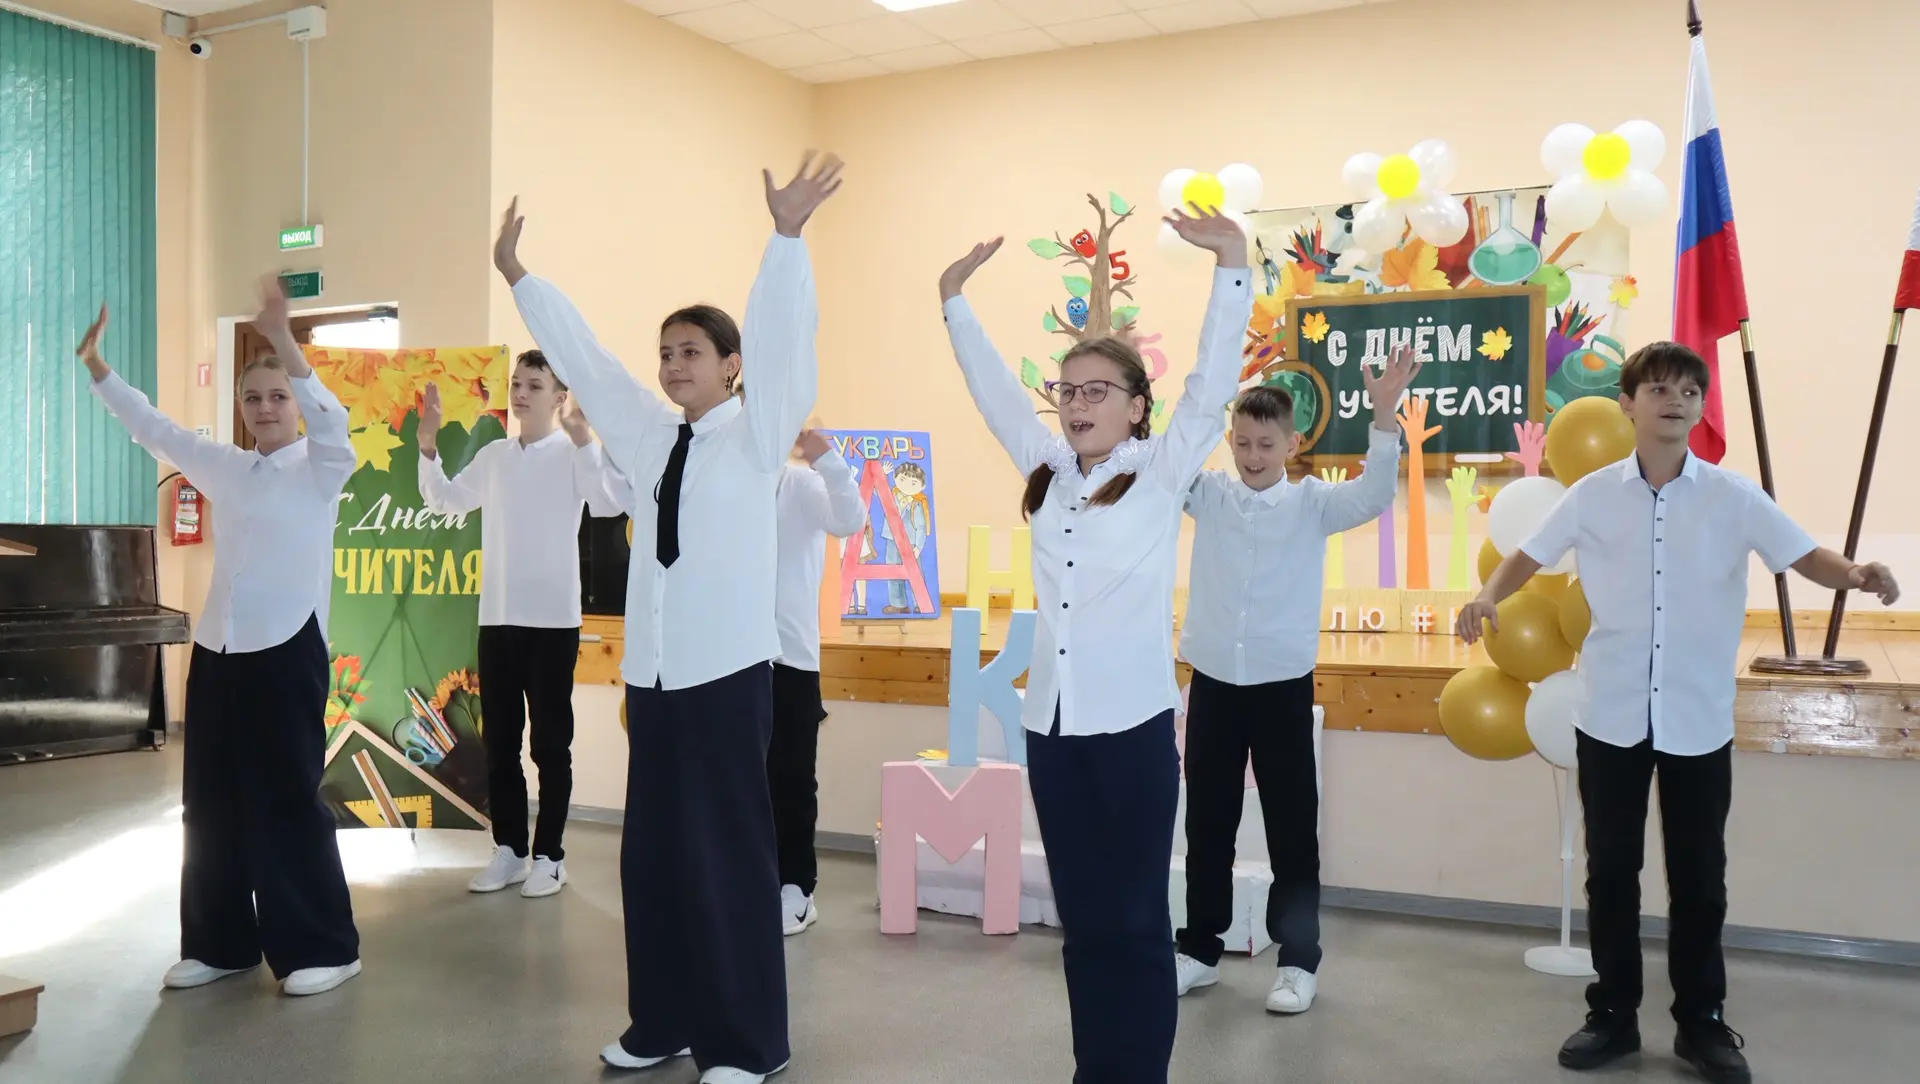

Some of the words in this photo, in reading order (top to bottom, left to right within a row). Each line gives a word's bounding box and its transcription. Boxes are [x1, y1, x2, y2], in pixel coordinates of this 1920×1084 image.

[282, 230, 312, 245] ВЫХОД
[1109, 250, 1130, 280] 5
[1327, 330, 1347, 367] С
[823, 436, 925, 460] УКВАРЬ
[334, 548, 482, 595] ЧИТЕЛЯ
